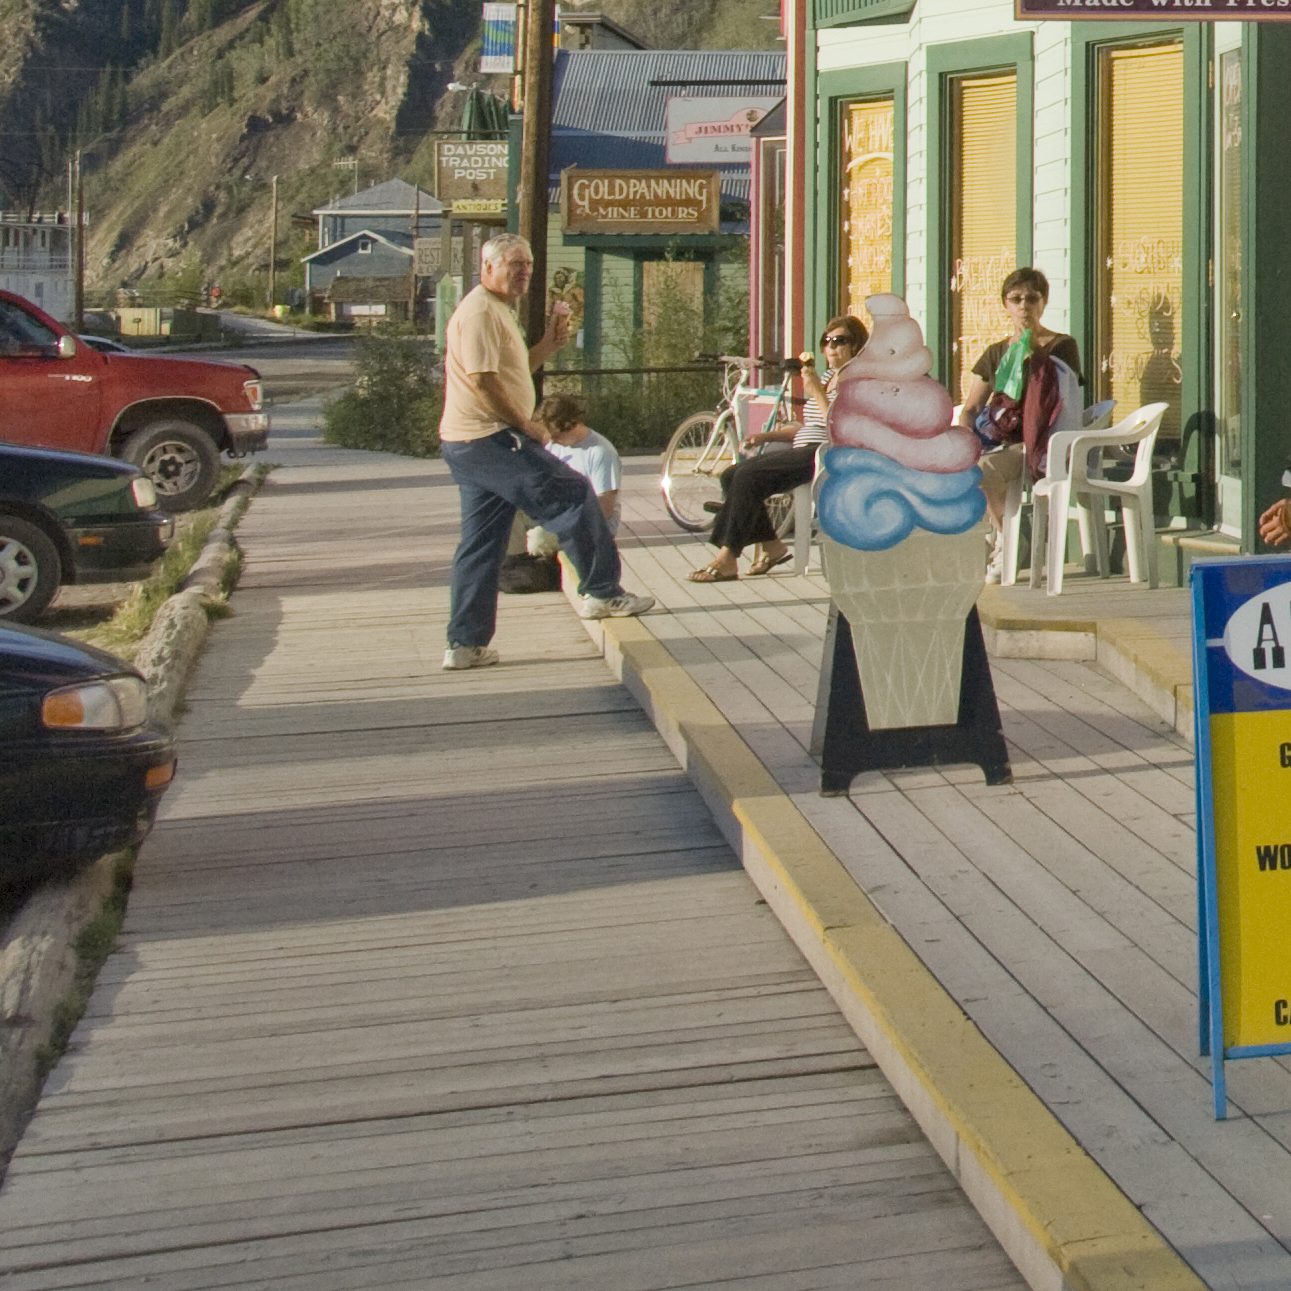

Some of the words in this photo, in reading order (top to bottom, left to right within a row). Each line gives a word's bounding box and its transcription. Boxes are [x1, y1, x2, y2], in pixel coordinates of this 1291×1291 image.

[444, 143, 508, 156] DAWSON
[454, 169, 497, 180] POST
[456, 202, 499, 211] ANTIQUES
[598, 206, 640, 219] MINE
[646, 206, 698, 219] TOURS
[418, 247, 478, 264] RESTRT
